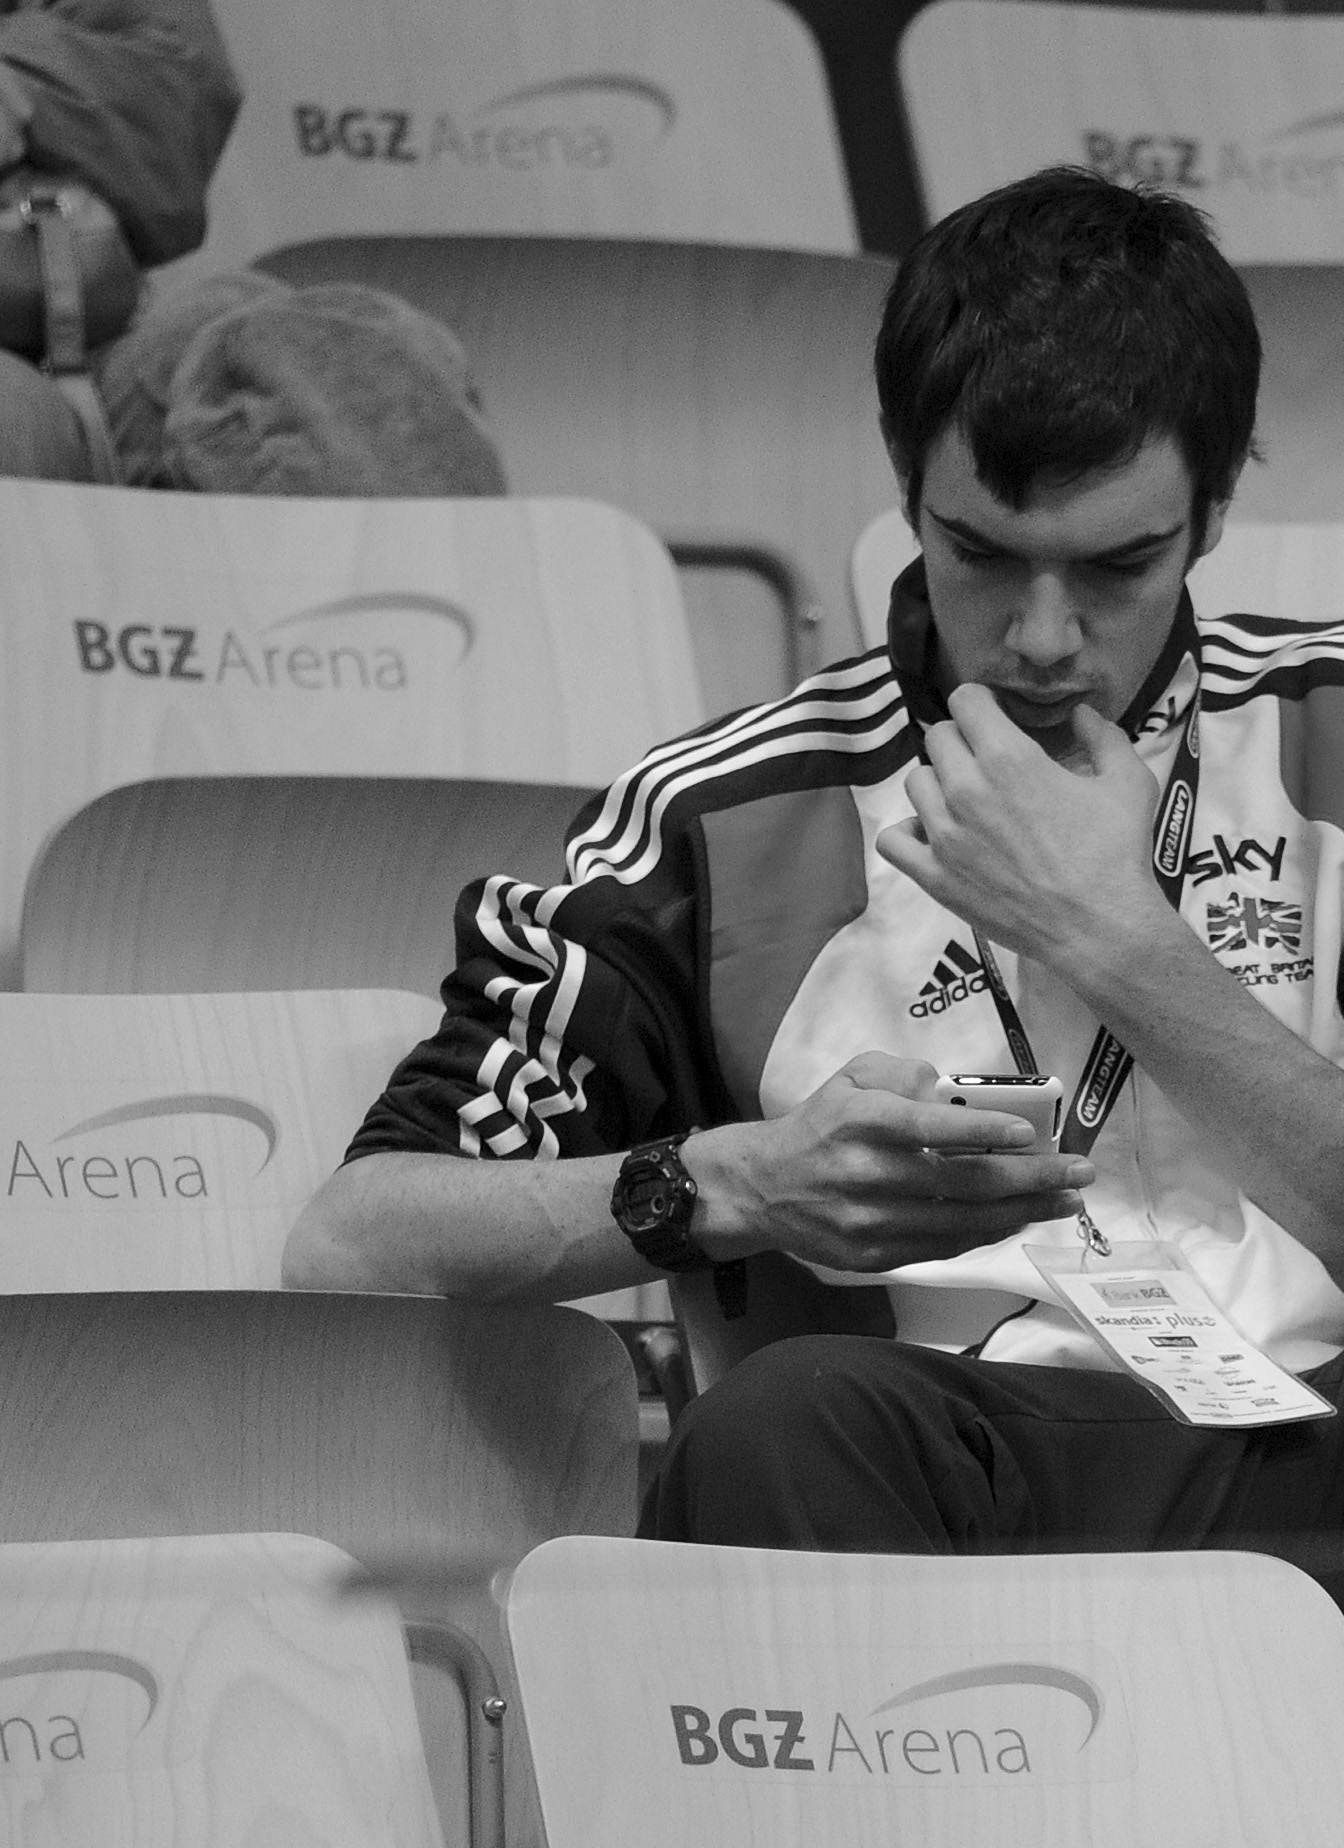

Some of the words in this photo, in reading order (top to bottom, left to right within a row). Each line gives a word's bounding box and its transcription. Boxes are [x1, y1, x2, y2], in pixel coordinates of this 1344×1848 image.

[429, 112, 614, 170] Arena
[215, 630, 408, 691] Arena
[1161, 788, 1189, 870] LANGTEAM
[909, 974, 991, 1018] adida
[1083, 1040, 1121, 1120] ANGTEAM
[8, 1140, 208, 1199] Arena
[828, 1712, 1031, 1775] Arena
